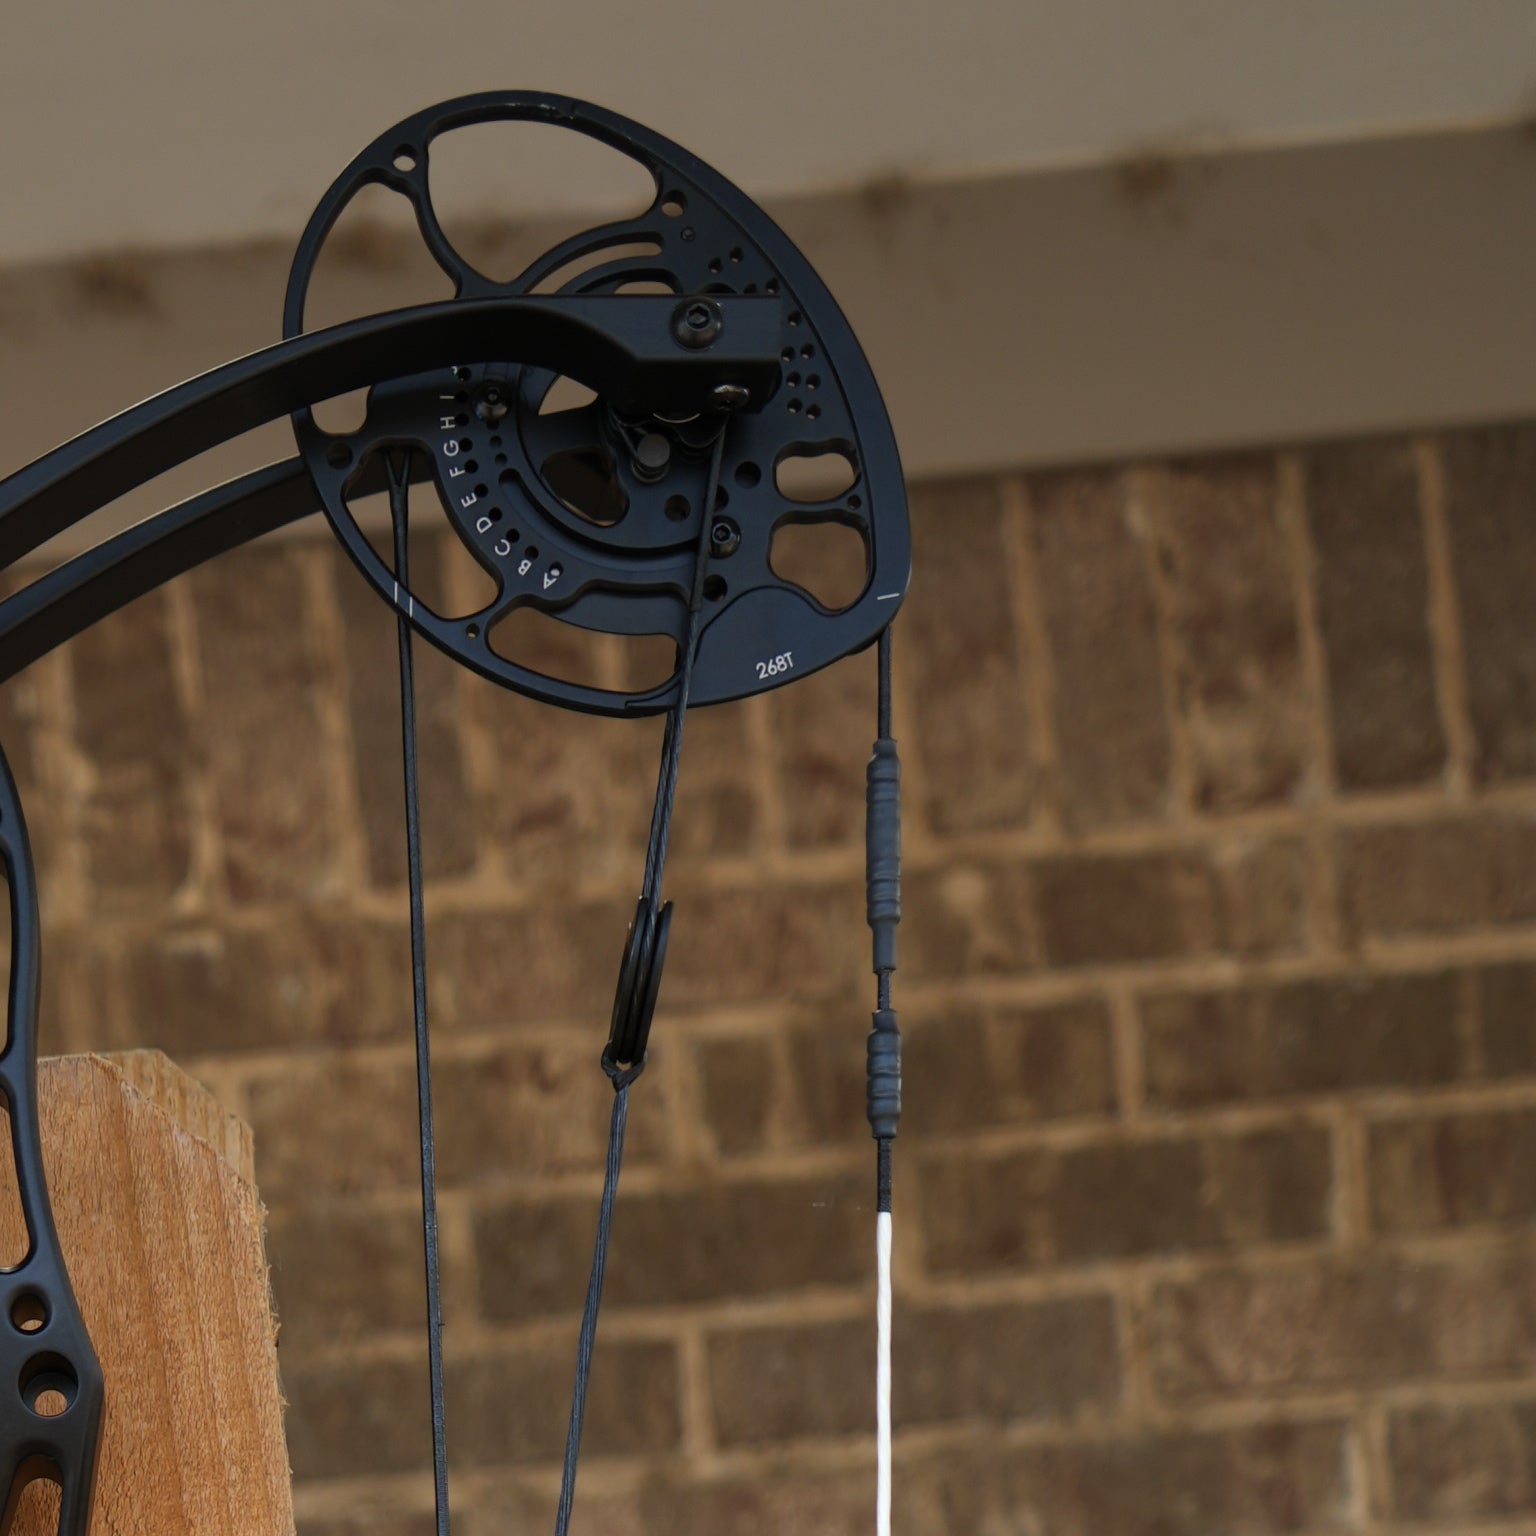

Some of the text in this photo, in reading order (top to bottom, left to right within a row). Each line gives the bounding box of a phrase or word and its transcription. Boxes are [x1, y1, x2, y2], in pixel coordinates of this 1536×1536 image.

[440, 416, 456, 429] H
[443, 439, 460, 457] G
[449, 466, 466, 478] F
[461, 492, 478, 508] E
[476, 516, 493, 534] D
[494, 538, 511, 556] C
[517, 559, 532, 576] B
[543, 572, 557, 589] A
[756, 651, 794, 680] 268T
